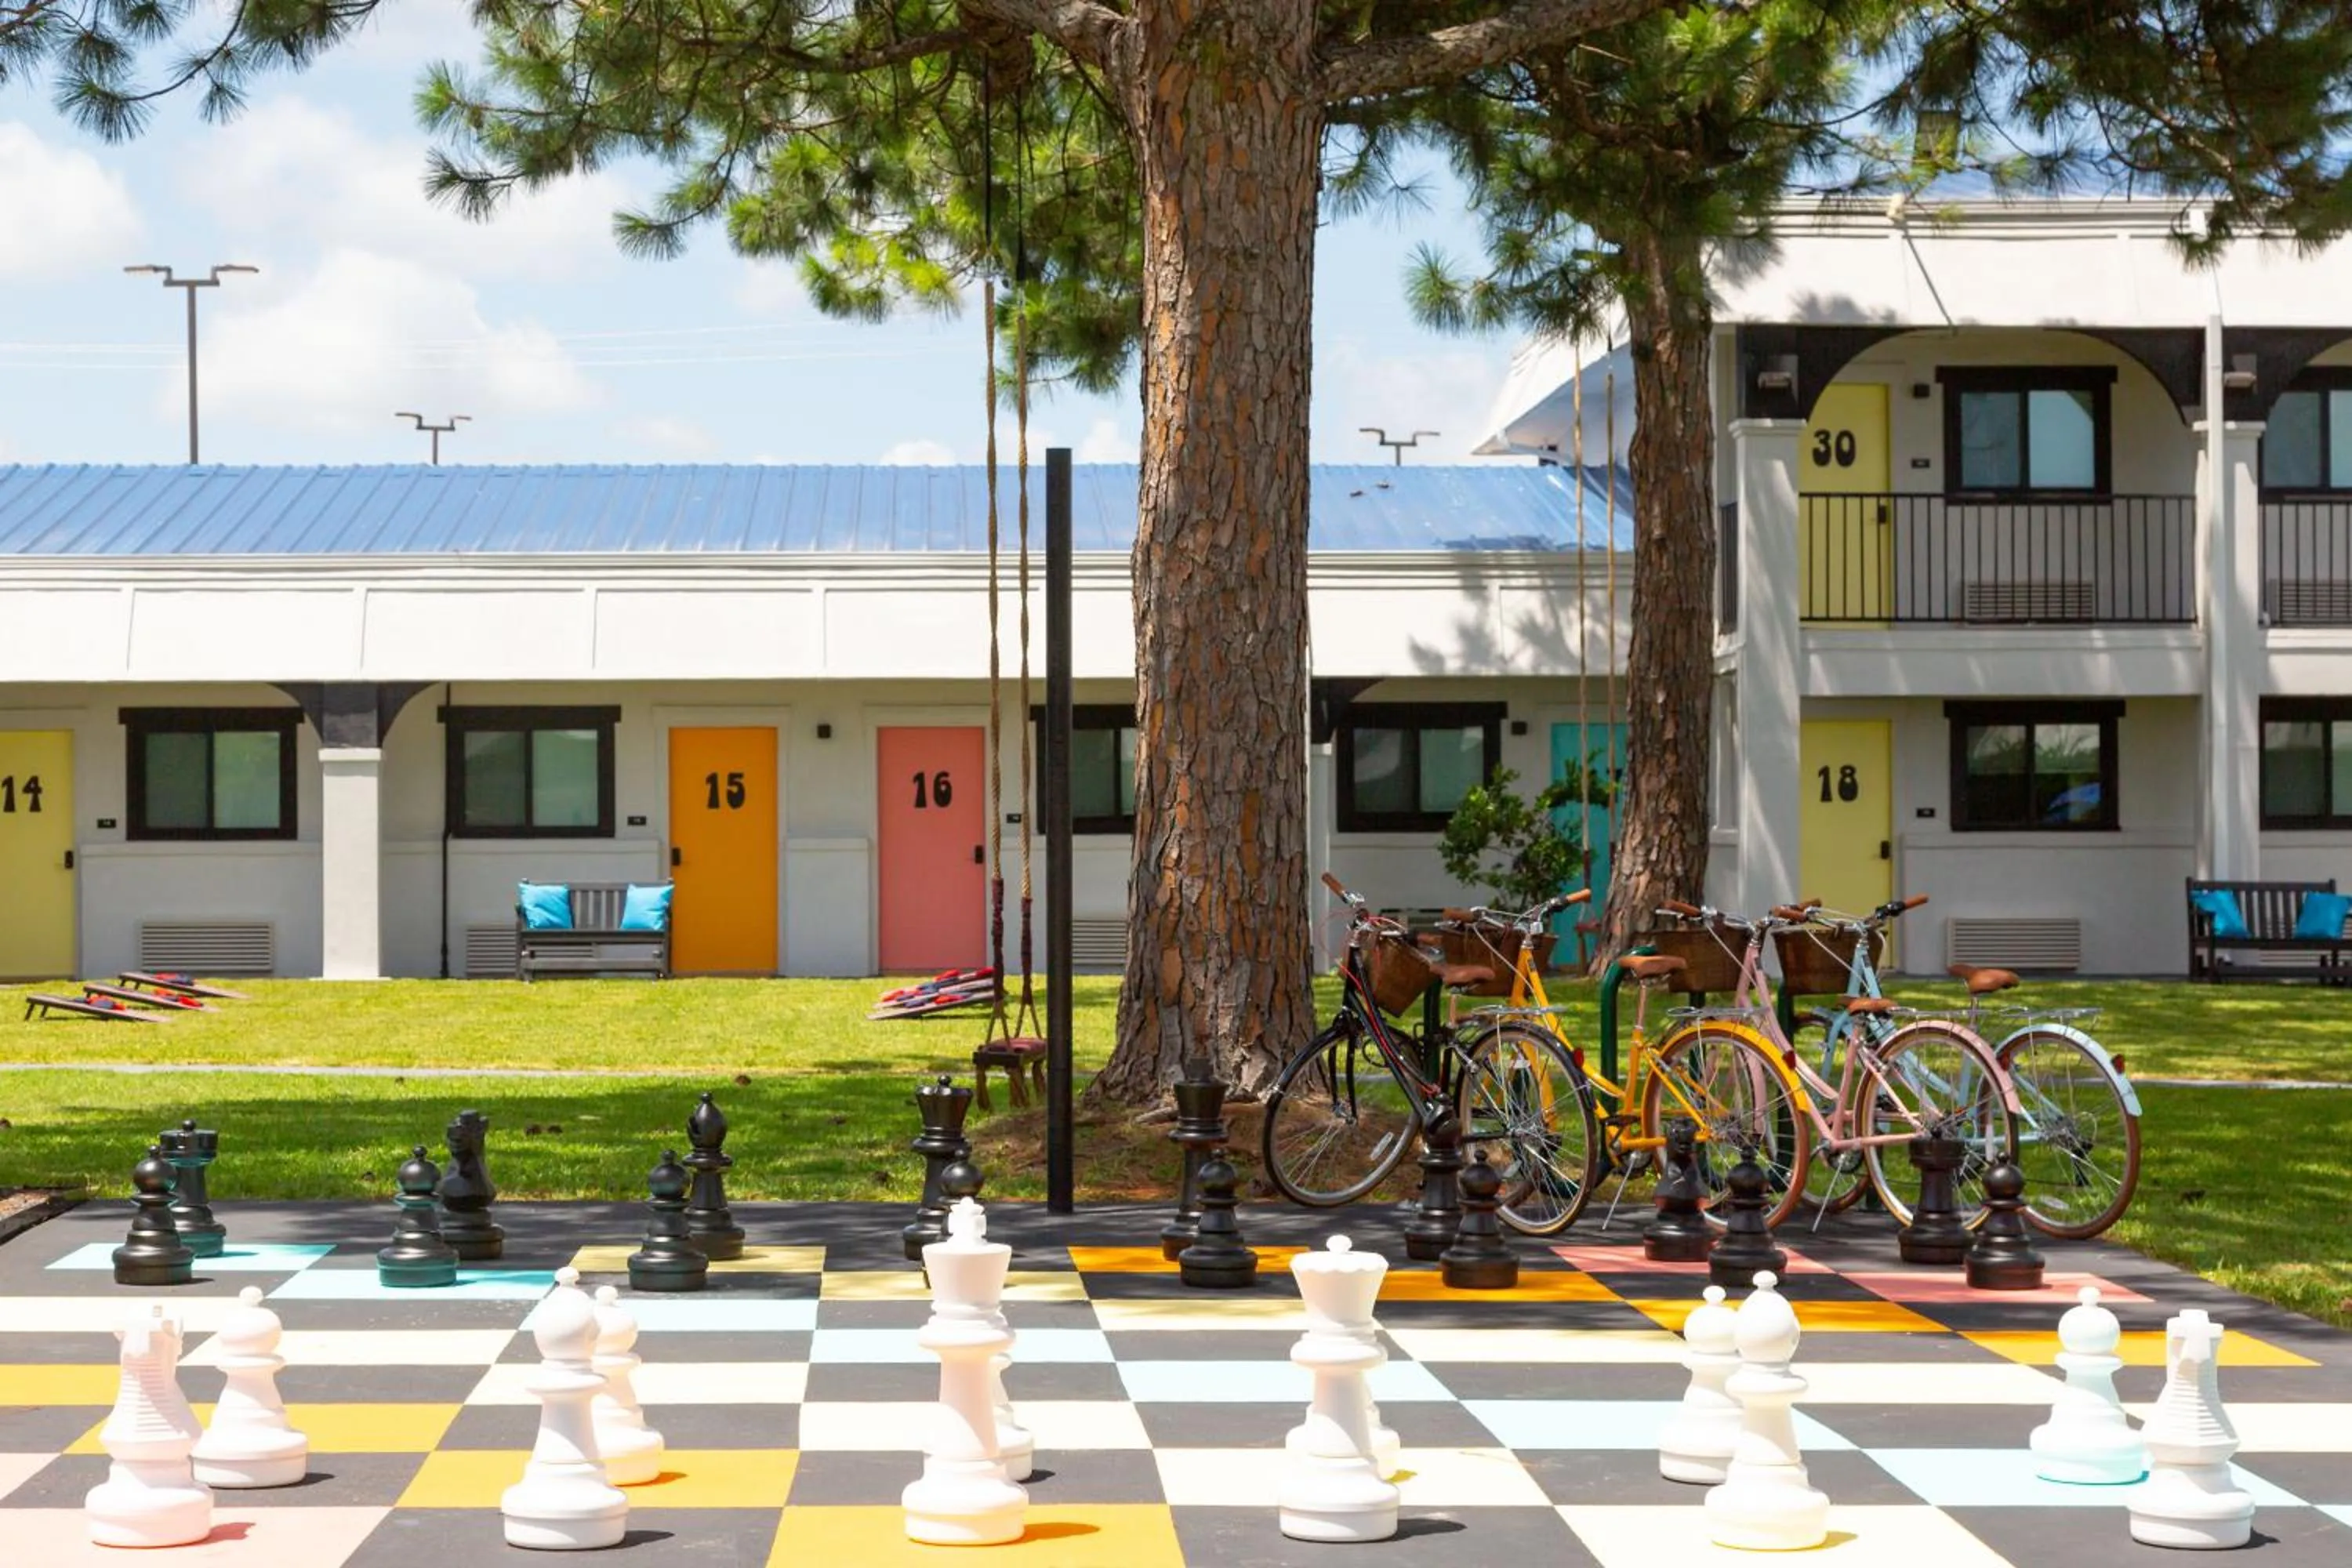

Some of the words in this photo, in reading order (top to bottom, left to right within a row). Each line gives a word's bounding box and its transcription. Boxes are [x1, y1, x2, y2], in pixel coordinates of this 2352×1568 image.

[1813, 430, 1856, 466] 30
[2, 775, 42, 812] 14
[706, 772, 745, 809] 15
[913, 771, 952, 808] 16
[1818, 764, 1858, 802] 18
